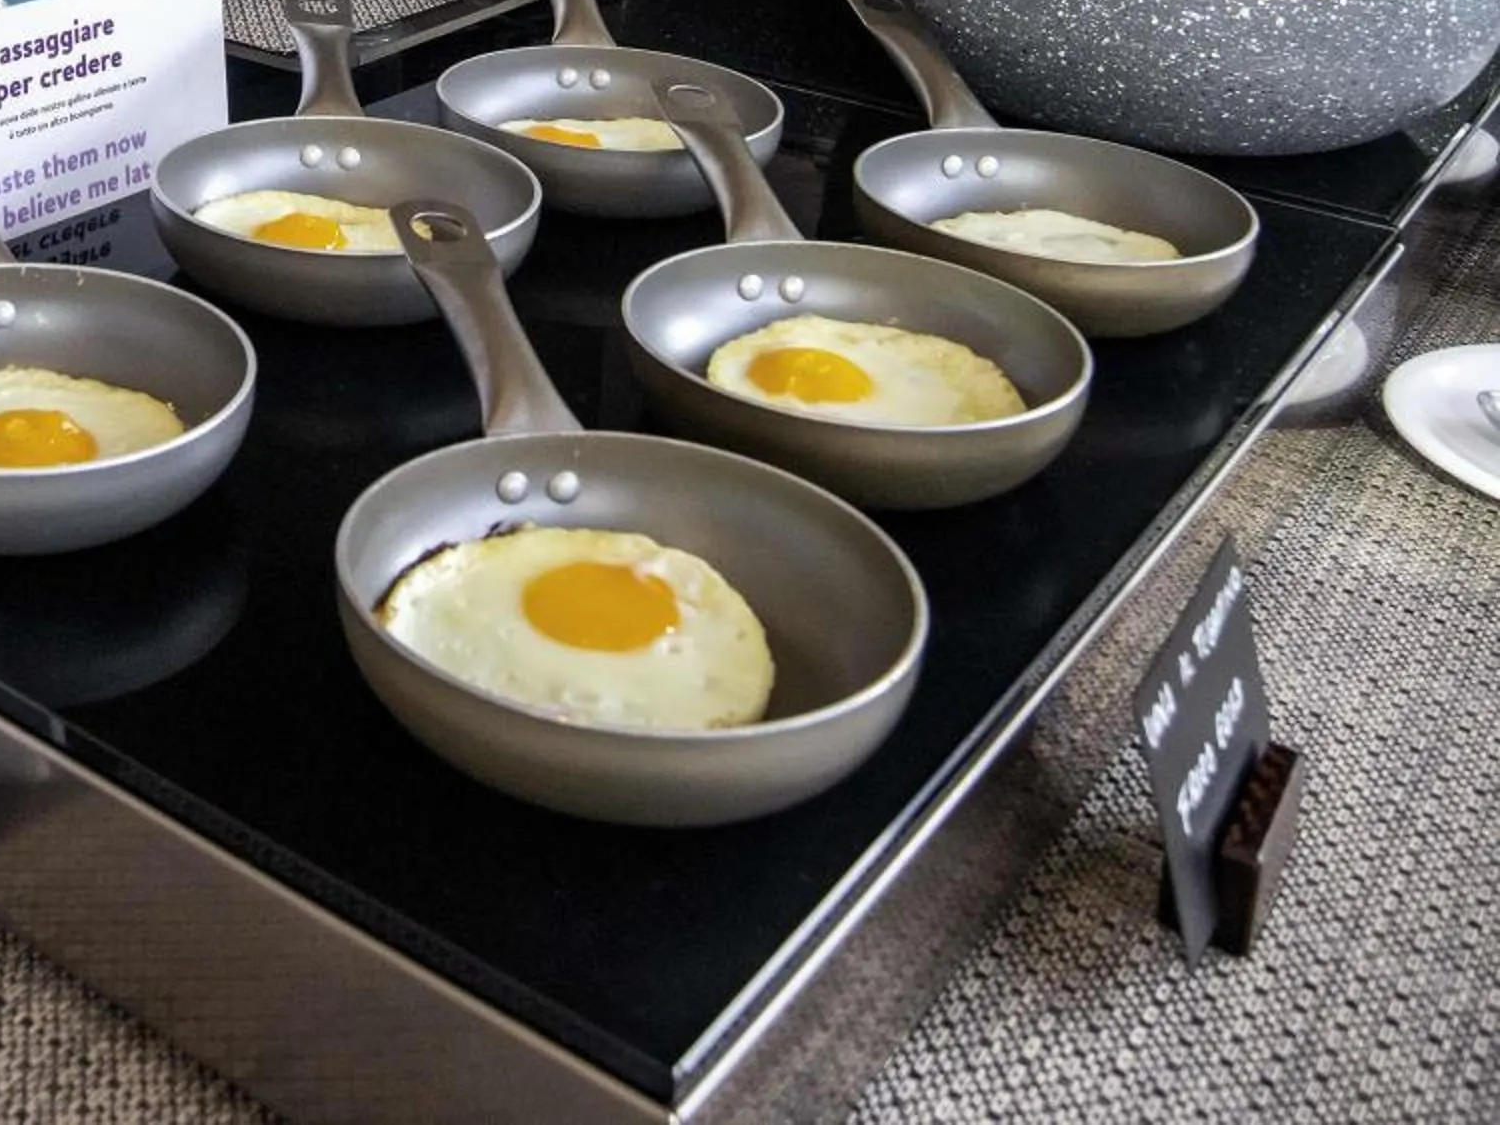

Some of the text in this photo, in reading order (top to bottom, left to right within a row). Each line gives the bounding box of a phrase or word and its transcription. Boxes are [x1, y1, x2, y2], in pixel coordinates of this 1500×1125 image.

[0, 16, 115, 64] assaggiare
[40, 49, 123, 88] credere
[41, 145, 99, 179] them
[105, 131, 148, 164] now
[3, 183, 82, 229] believe
[88, 172, 119, 199] me
[125, 161, 152, 187] lat
